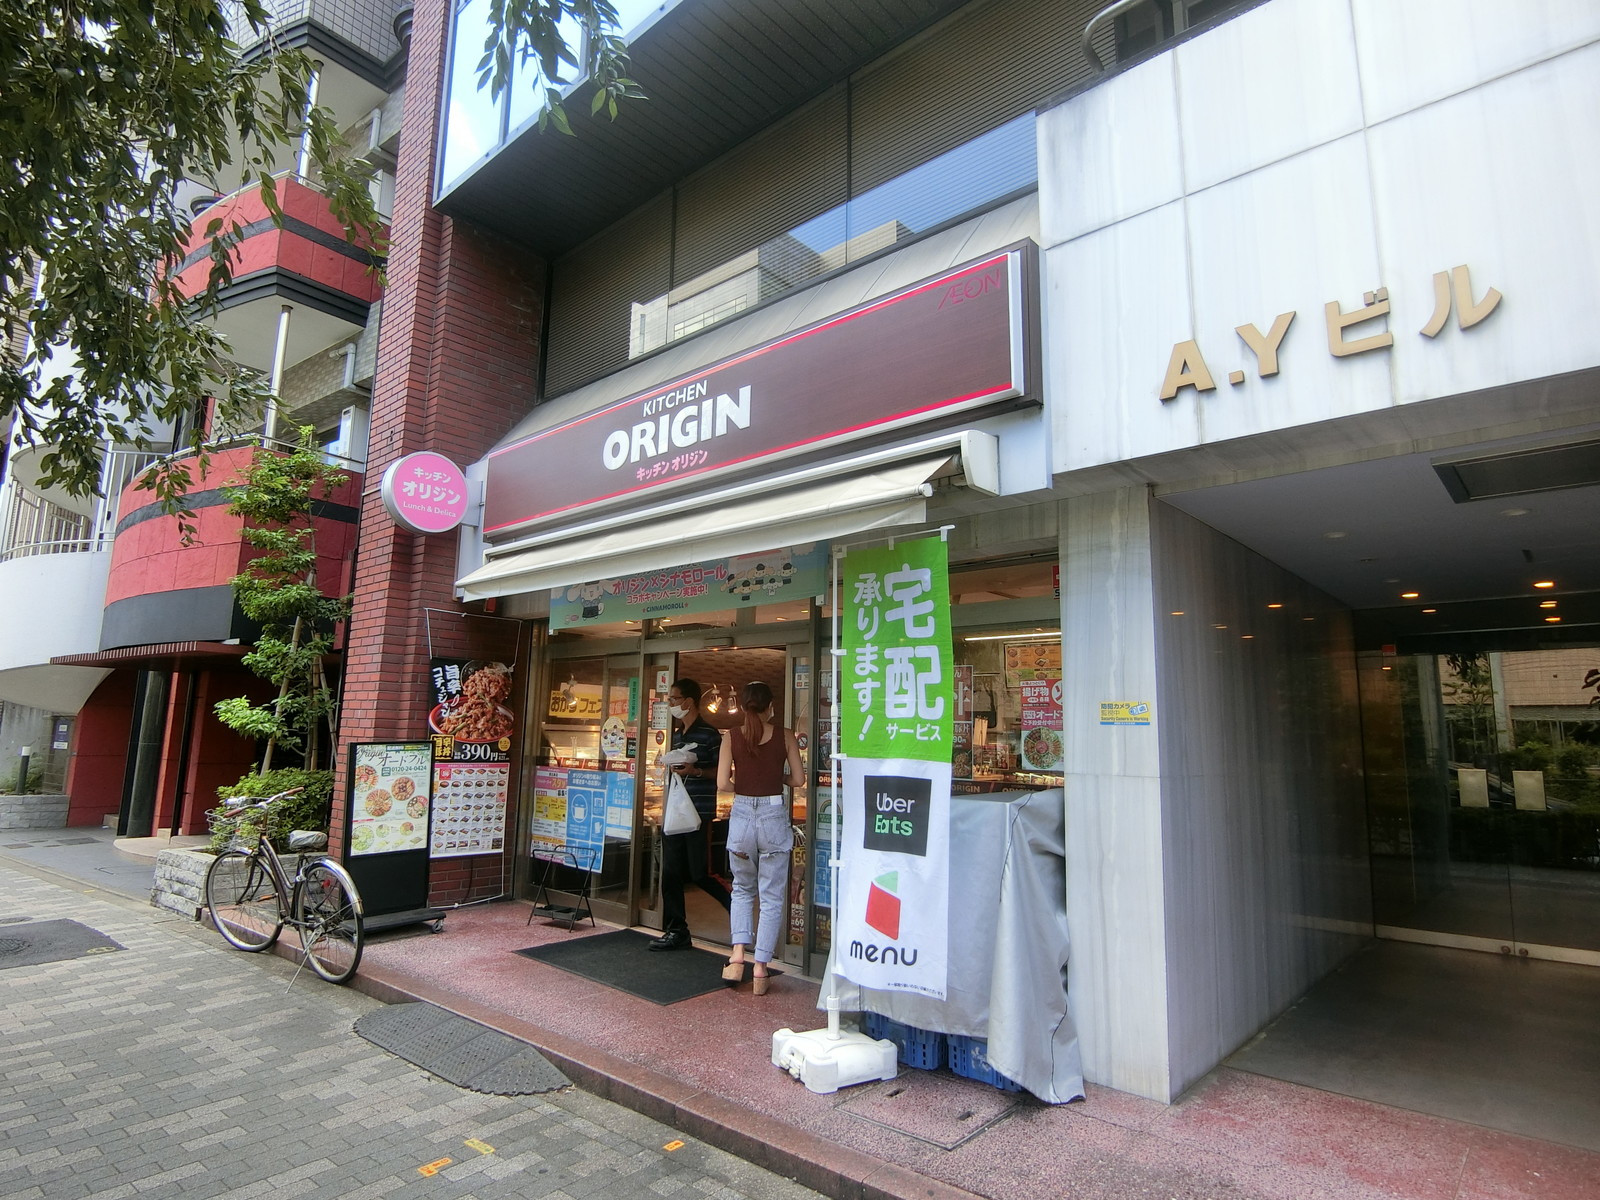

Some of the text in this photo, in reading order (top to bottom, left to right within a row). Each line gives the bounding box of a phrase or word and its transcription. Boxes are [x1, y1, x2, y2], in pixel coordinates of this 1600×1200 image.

[643, 380, 708, 417] KITCHEN
[603, 385, 752, 471] ORIGIN
[414, 467, 451, 483] キッチン
[636, 450, 708, 481] キッチン オリジン
[402, 481, 461, 505] オリジン
[403, 501, 425, 511] Lunch
[435, 507, 456, 517] Delica
[646, 603, 684, 613] CINNAMOROLL
[883, 563, 945, 720] 宅配
[885, 722, 941, 741] サービス
[876, 793, 915, 814] Uber
[874, 814, 913, 836] Eats
[850, 940, 918, 966] menu
